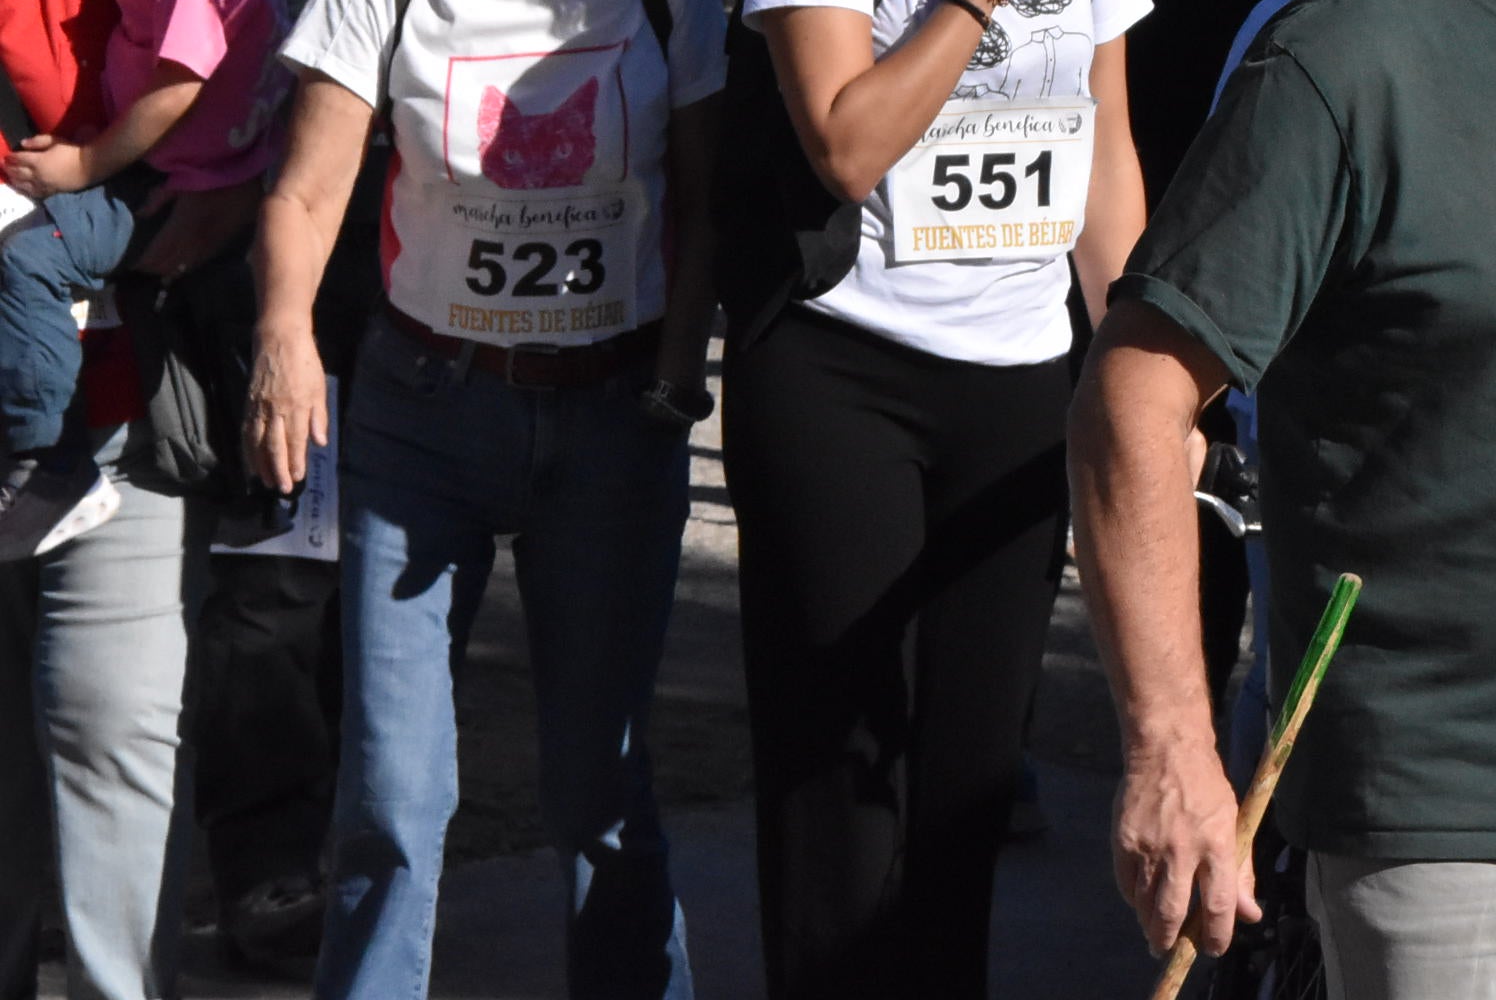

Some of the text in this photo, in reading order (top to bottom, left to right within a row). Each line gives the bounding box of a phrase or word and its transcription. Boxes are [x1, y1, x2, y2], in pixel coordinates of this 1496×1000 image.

[931, 150, 1052, 212] 551
[452, 202, 511, 229] marcha
[912, 216, 1075, 251] FUENTES DE BÉJAR
[465, 238, 606, 297] 523
[448, 303, 533, 333] FUENTES
[539, 308, 565, 333] DE
